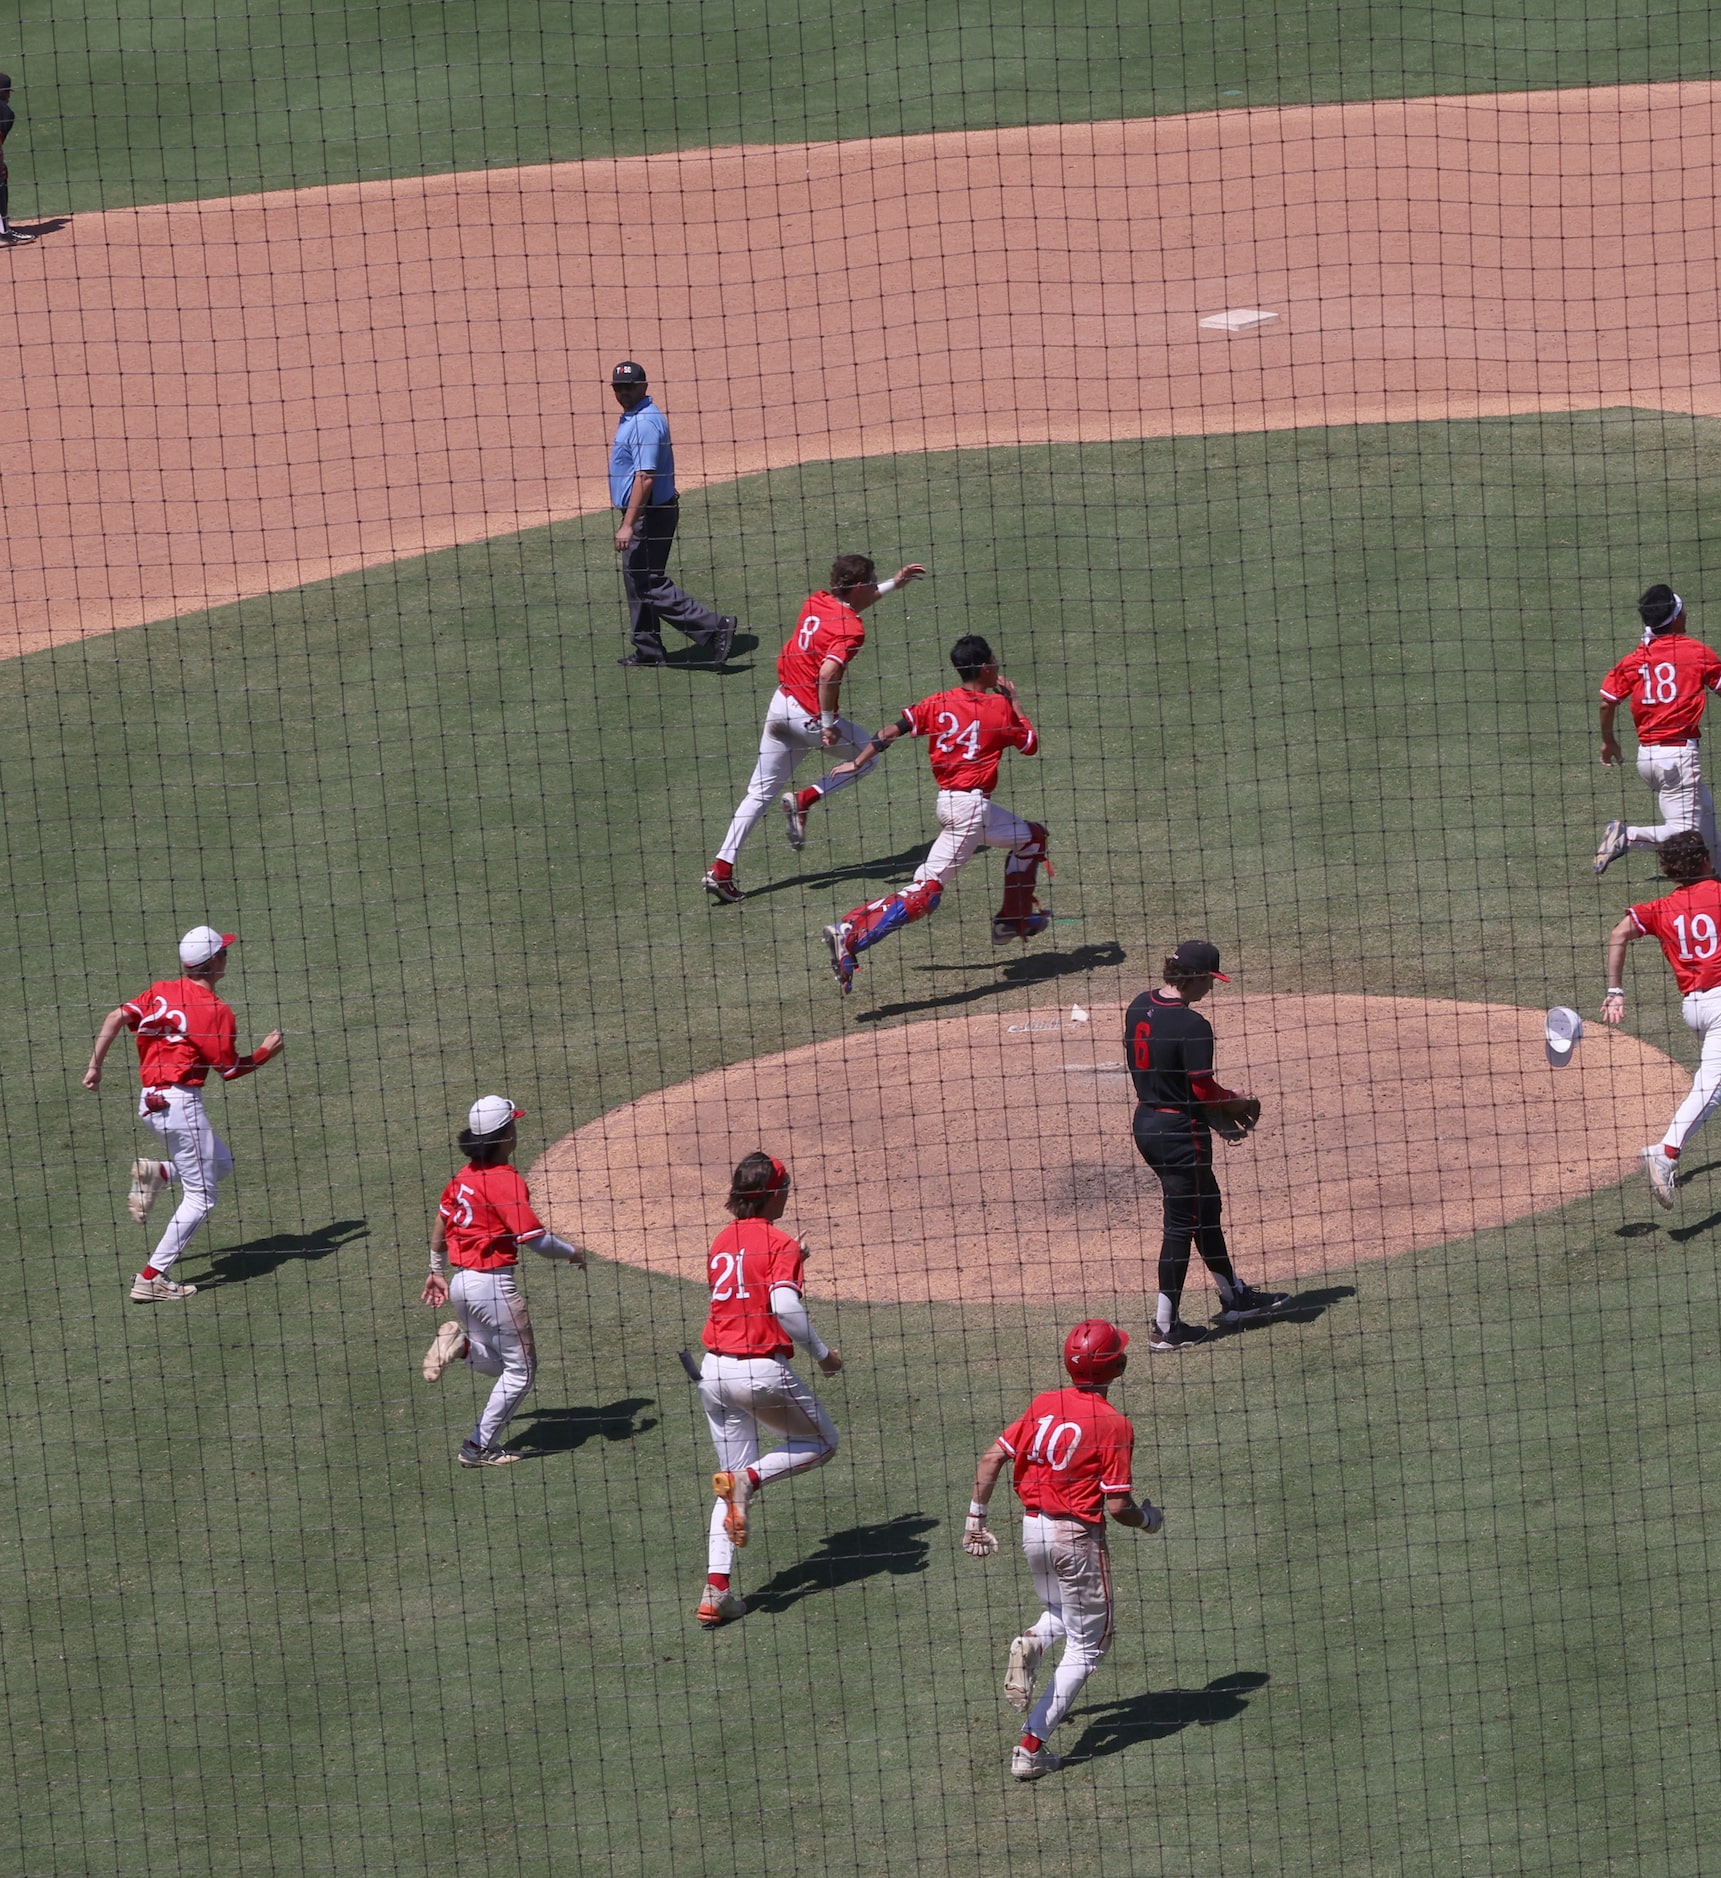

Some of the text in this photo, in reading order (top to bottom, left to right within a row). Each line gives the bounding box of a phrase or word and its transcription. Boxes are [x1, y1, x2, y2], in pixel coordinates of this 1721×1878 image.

[797, 615, 821, 651] 8
[1638, 662, 1677, 705] 18
[935, 711, 981, 760] 24
[1672, 913, 1719, 960] 19
[1133, 1021, 1152, 1070] 6
[453, 1183, 474, 1229] 5
[710, 1247, 751, 1302] 21
[1026, 1413, 1083, 1472] 10
